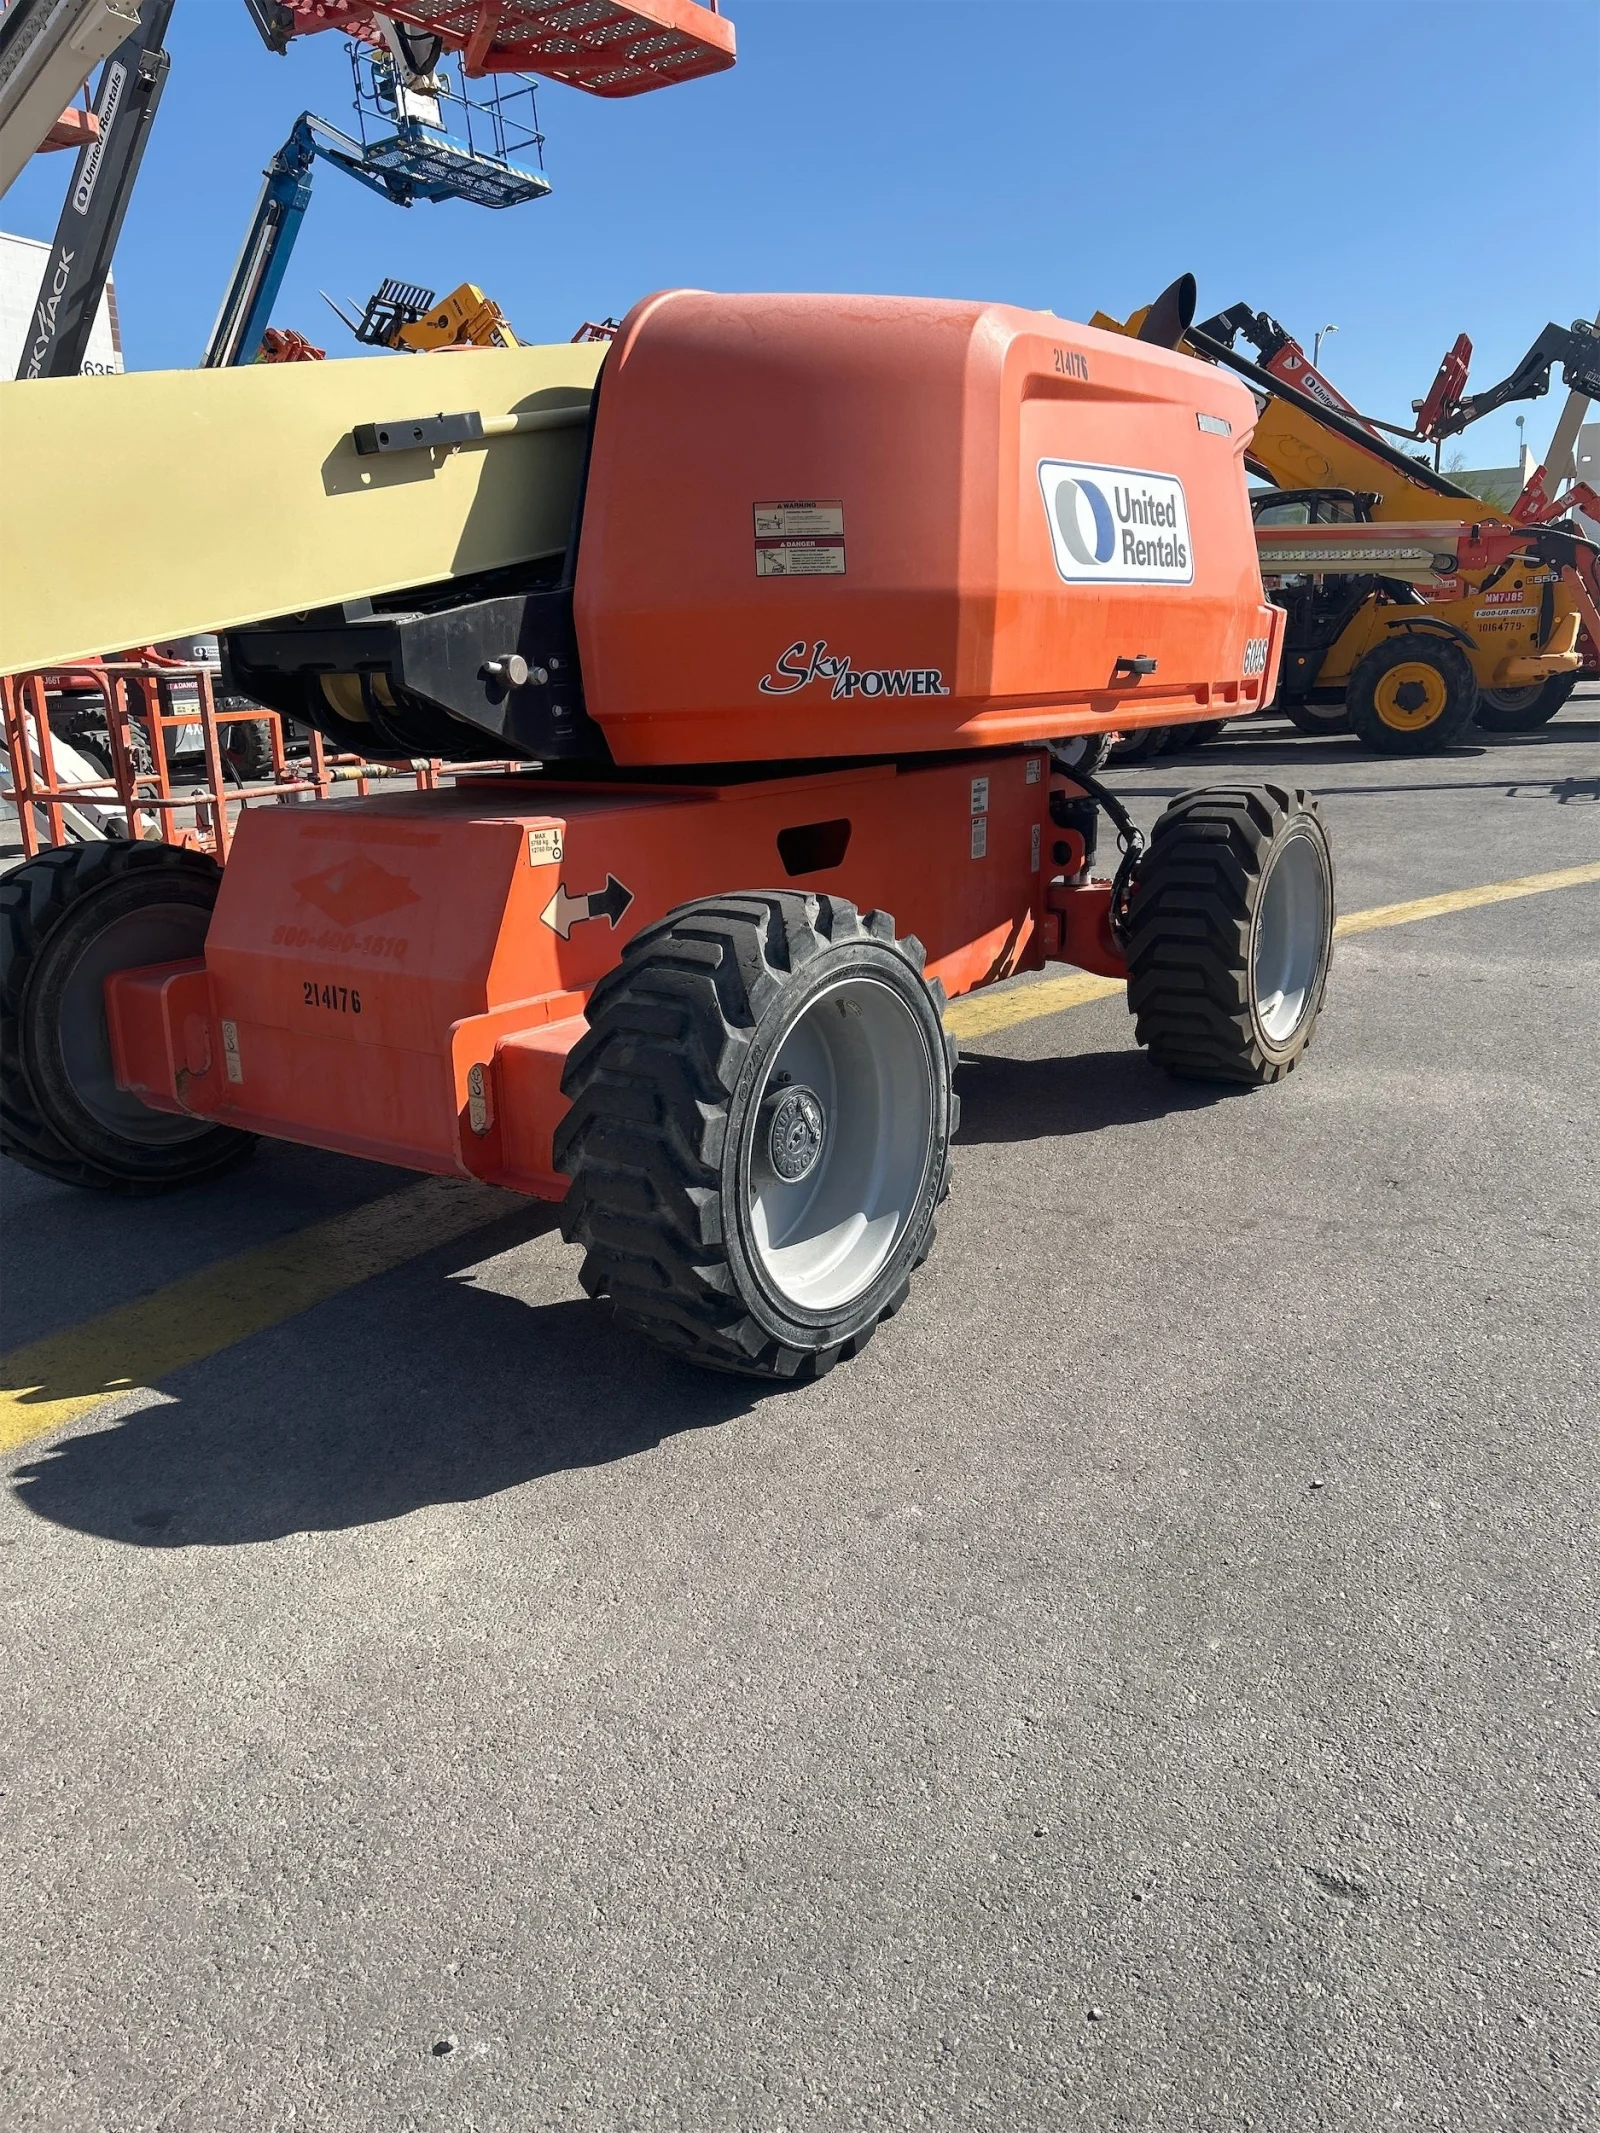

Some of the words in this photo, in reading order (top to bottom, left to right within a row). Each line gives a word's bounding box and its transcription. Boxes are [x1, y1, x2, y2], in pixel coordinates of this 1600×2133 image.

[99, 73, 122, 134] Rentals
[1053, 348, 1089, 381] 214176
[783, 502, 817, 510] WARNING
[1114, 486, 1177, 528] United
[1121, 528, 1187, 569] Rentals
[1476, 607, 1537, 617] 1-800-UR-RENTS
[178, 681, 199, 690] DANGE
[186, 723, 203, 736] 4X
[534, 832, 547, 840] MAX
[303, 981, 361, 1013] 214176
